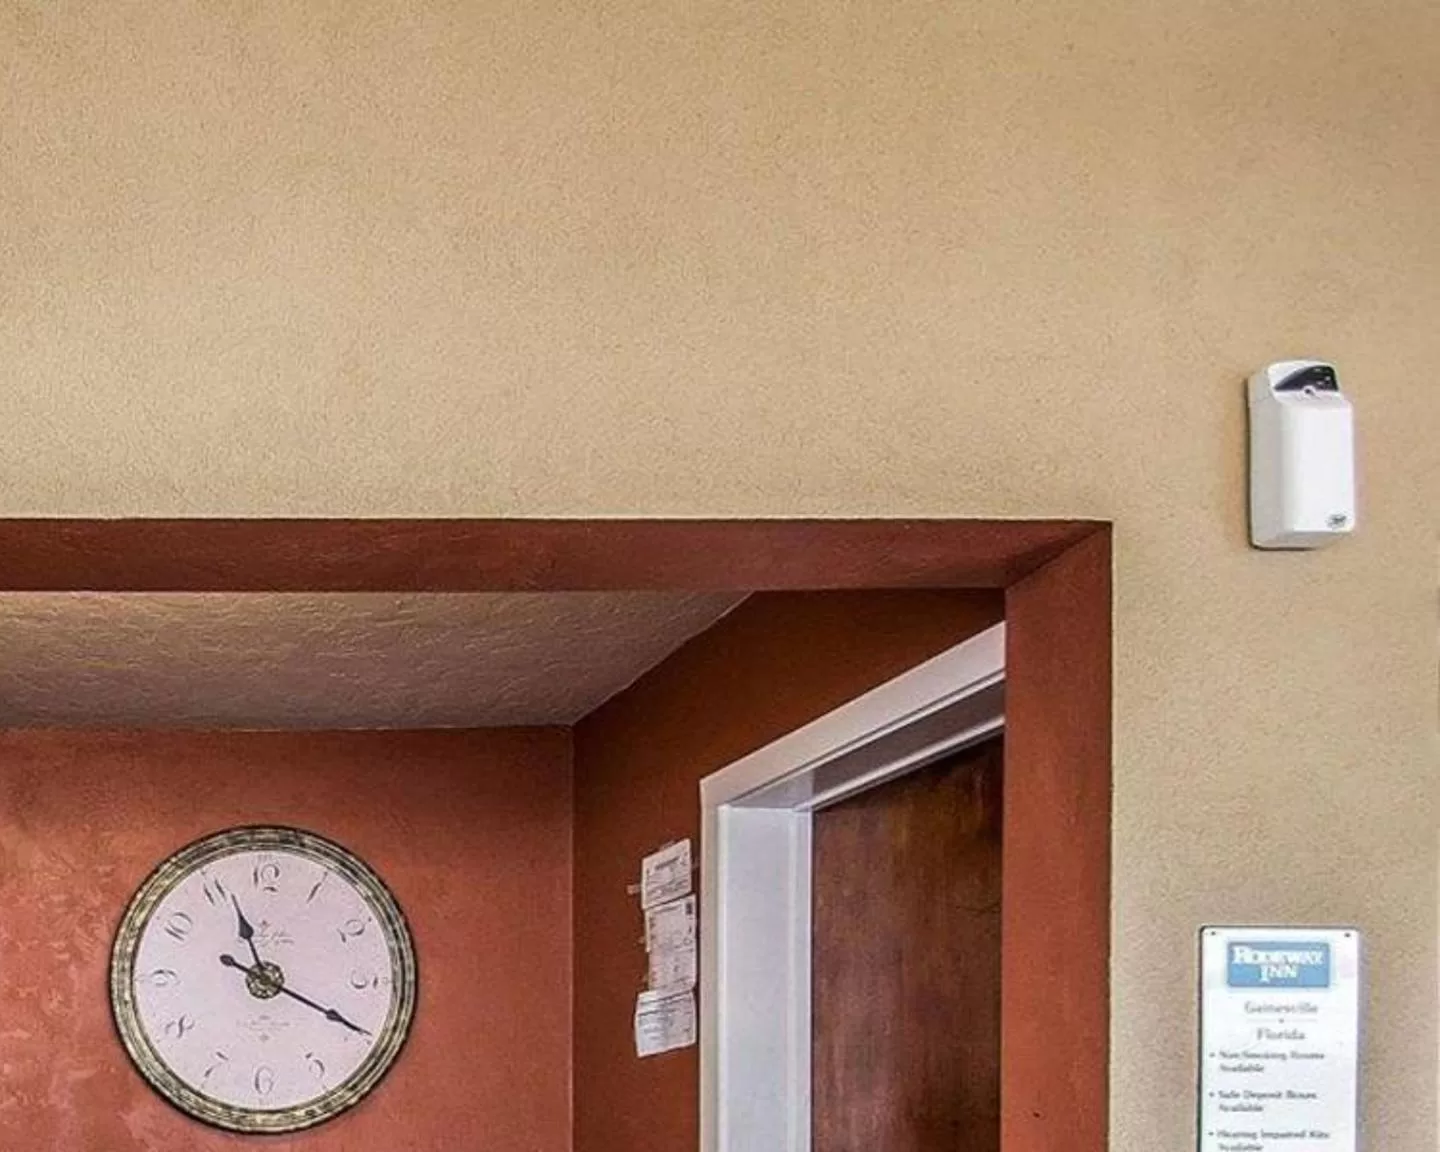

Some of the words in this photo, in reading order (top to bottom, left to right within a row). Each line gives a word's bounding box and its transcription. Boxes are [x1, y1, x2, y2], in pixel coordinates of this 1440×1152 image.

[252, 863, 280, 893] 12
[1260, 965, 1298, 982] INN
[1256, 1028, 1306, 1041] Florida
